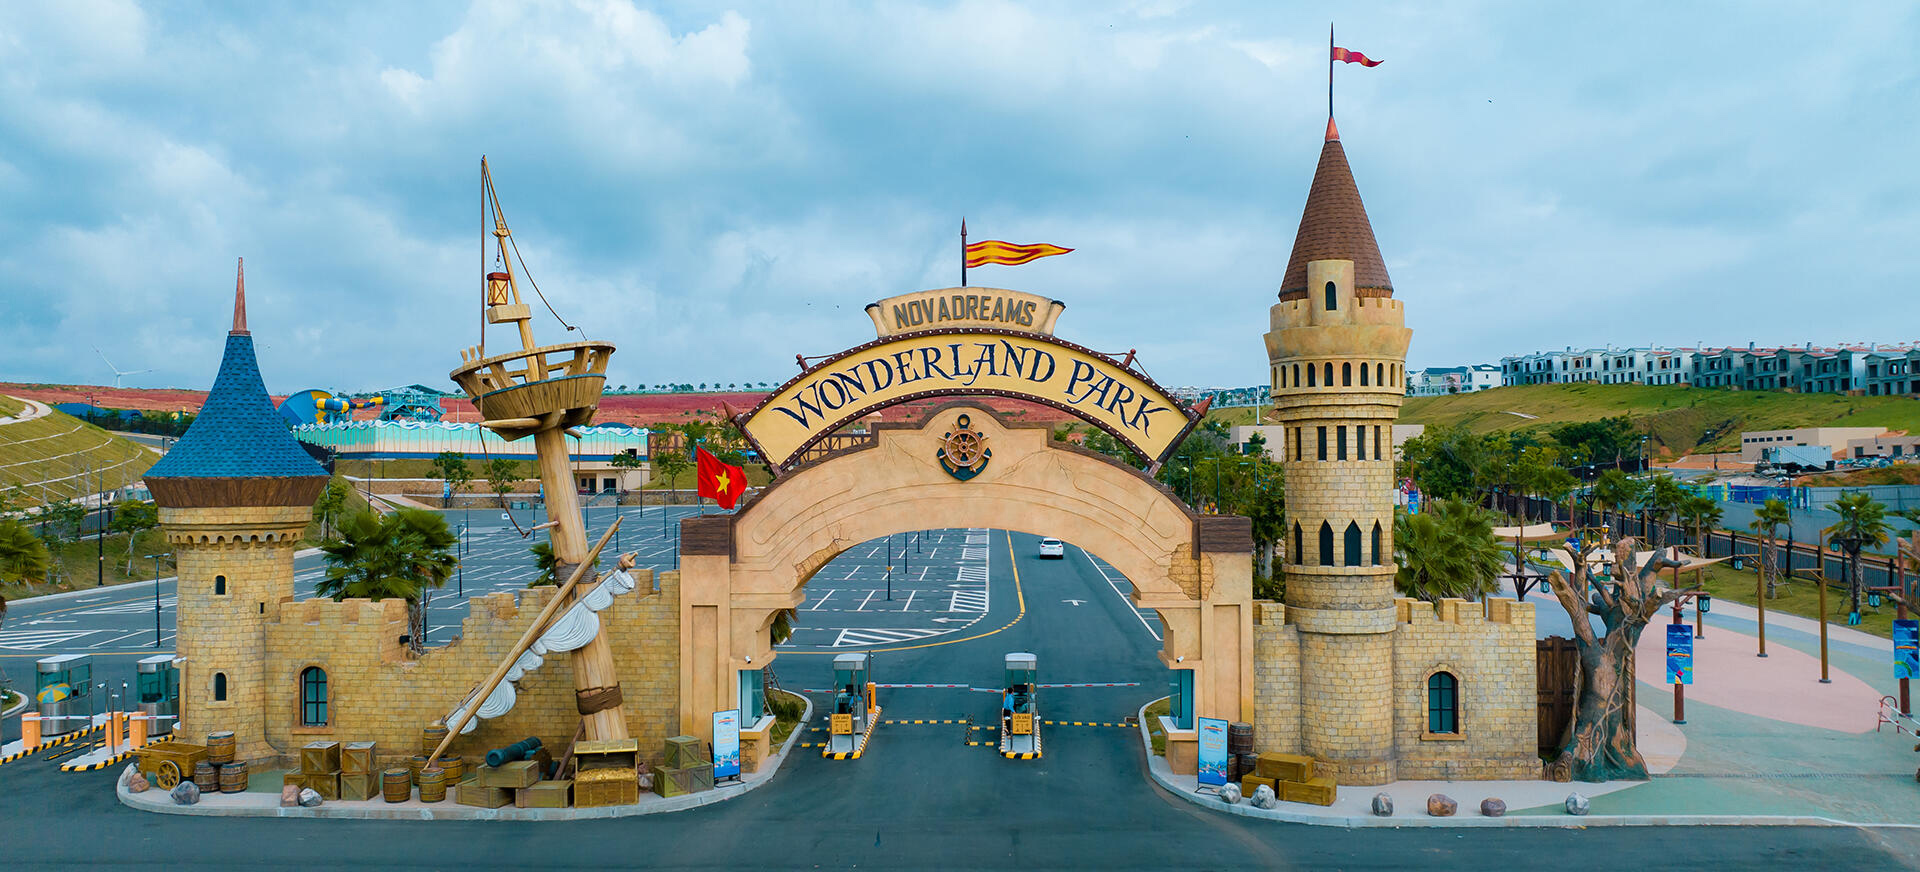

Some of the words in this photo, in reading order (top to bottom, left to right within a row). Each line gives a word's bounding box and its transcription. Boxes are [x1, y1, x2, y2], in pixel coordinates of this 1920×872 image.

[894, 295, 1037, 328] NOVADREAMS
[773, 340, 1056, 431] WONDERLAND
[1066, 358, 1171, 438] PARK
